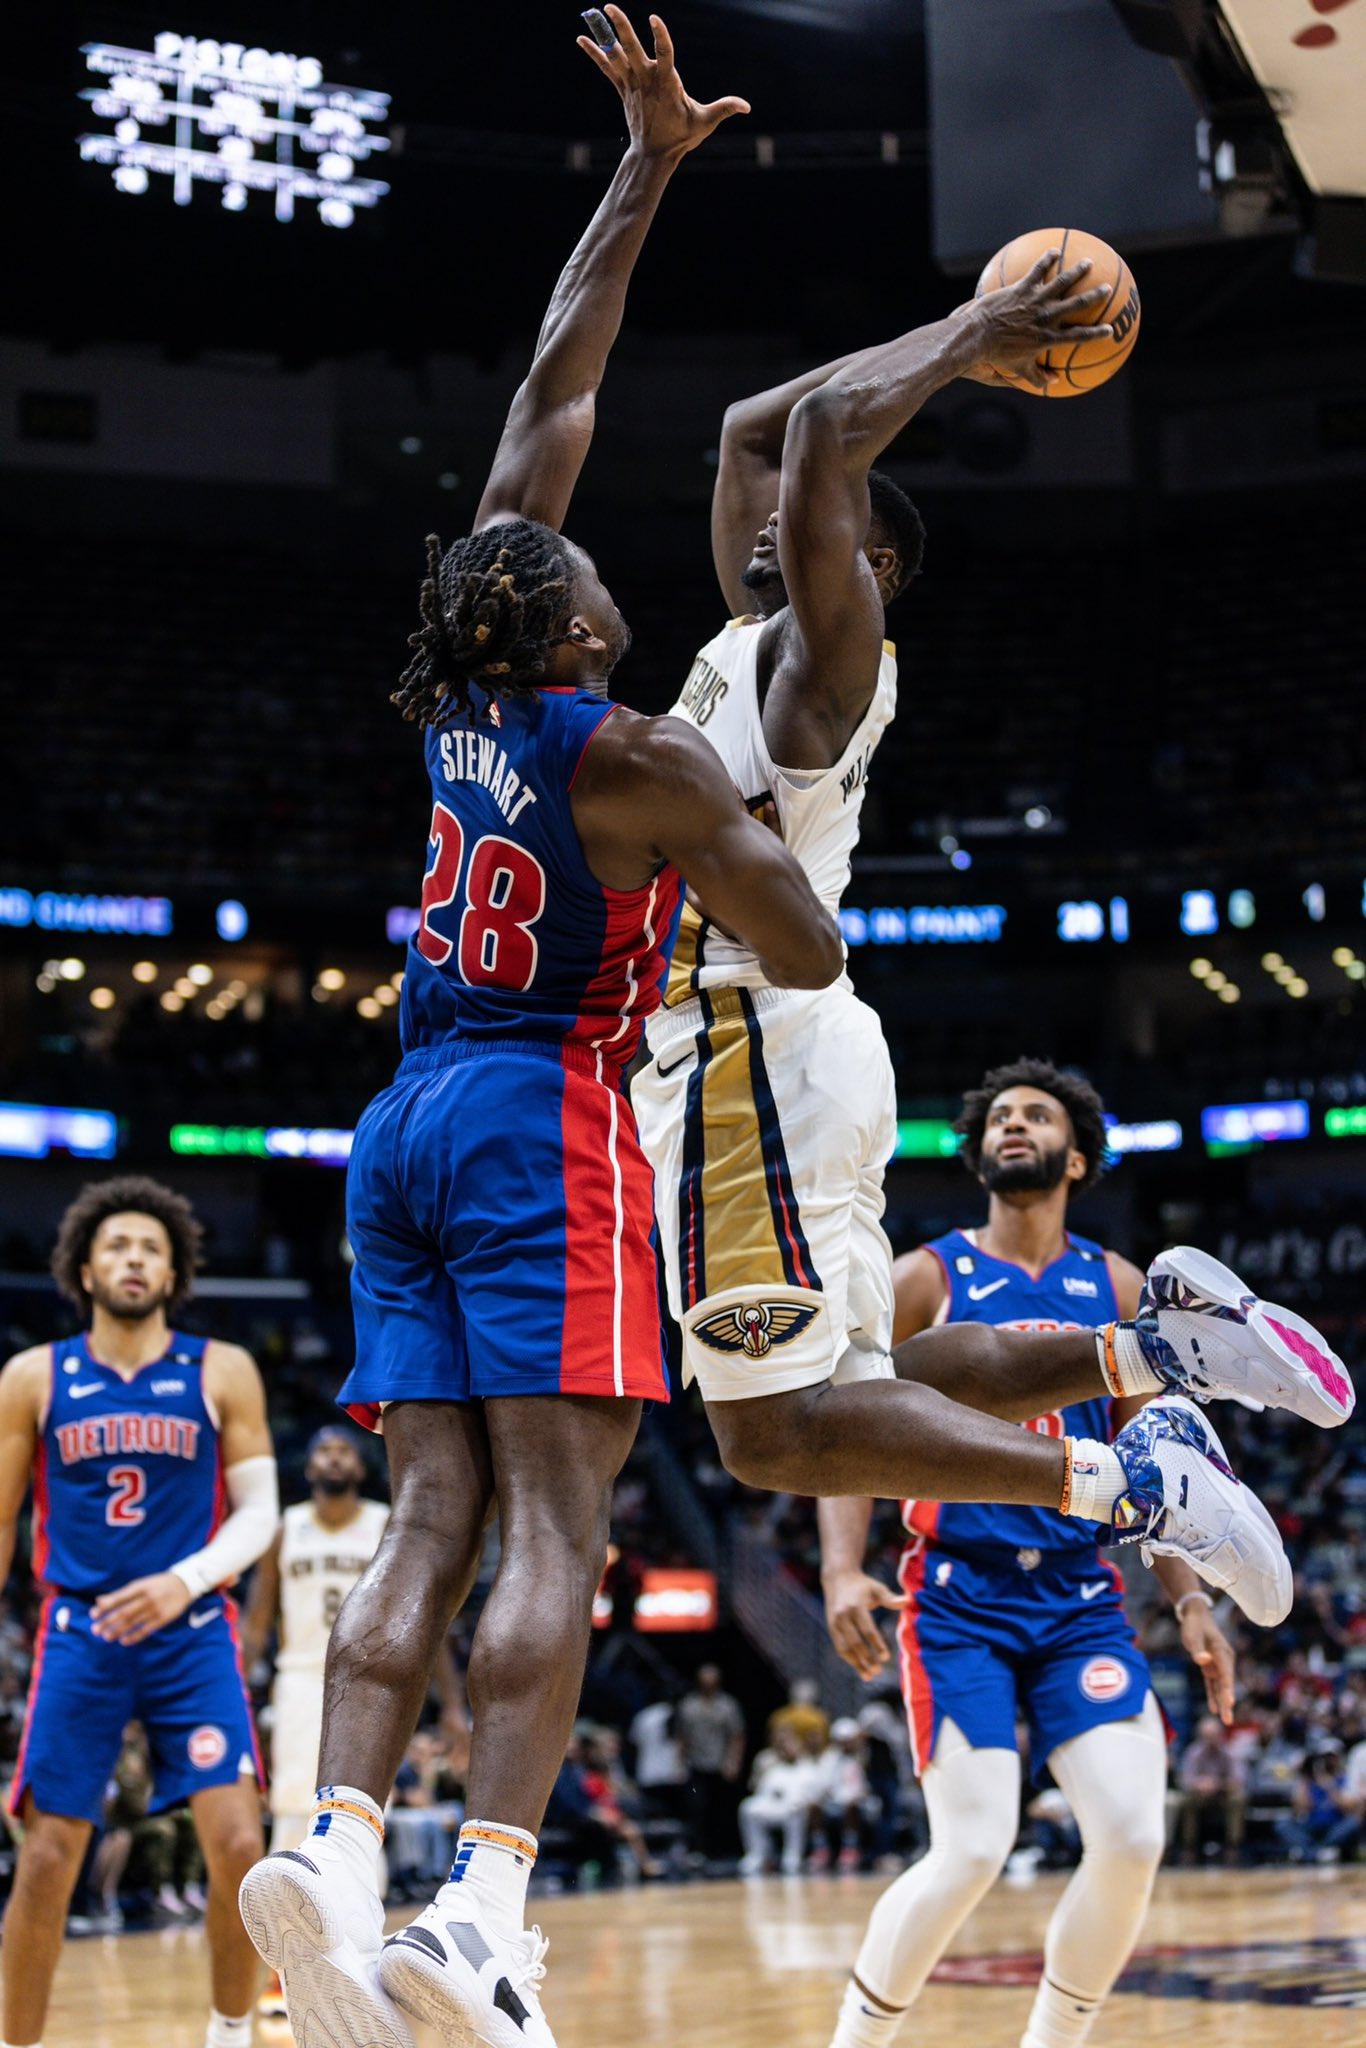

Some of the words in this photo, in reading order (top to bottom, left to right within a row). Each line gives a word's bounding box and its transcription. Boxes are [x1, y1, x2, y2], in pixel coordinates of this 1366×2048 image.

[440, 729, 537, 826] STEWART
[417, 801, 546, 992] 28
[55, 1413, 200, 1466] DETROIT
[105, 1465, 148, 1527] 2
